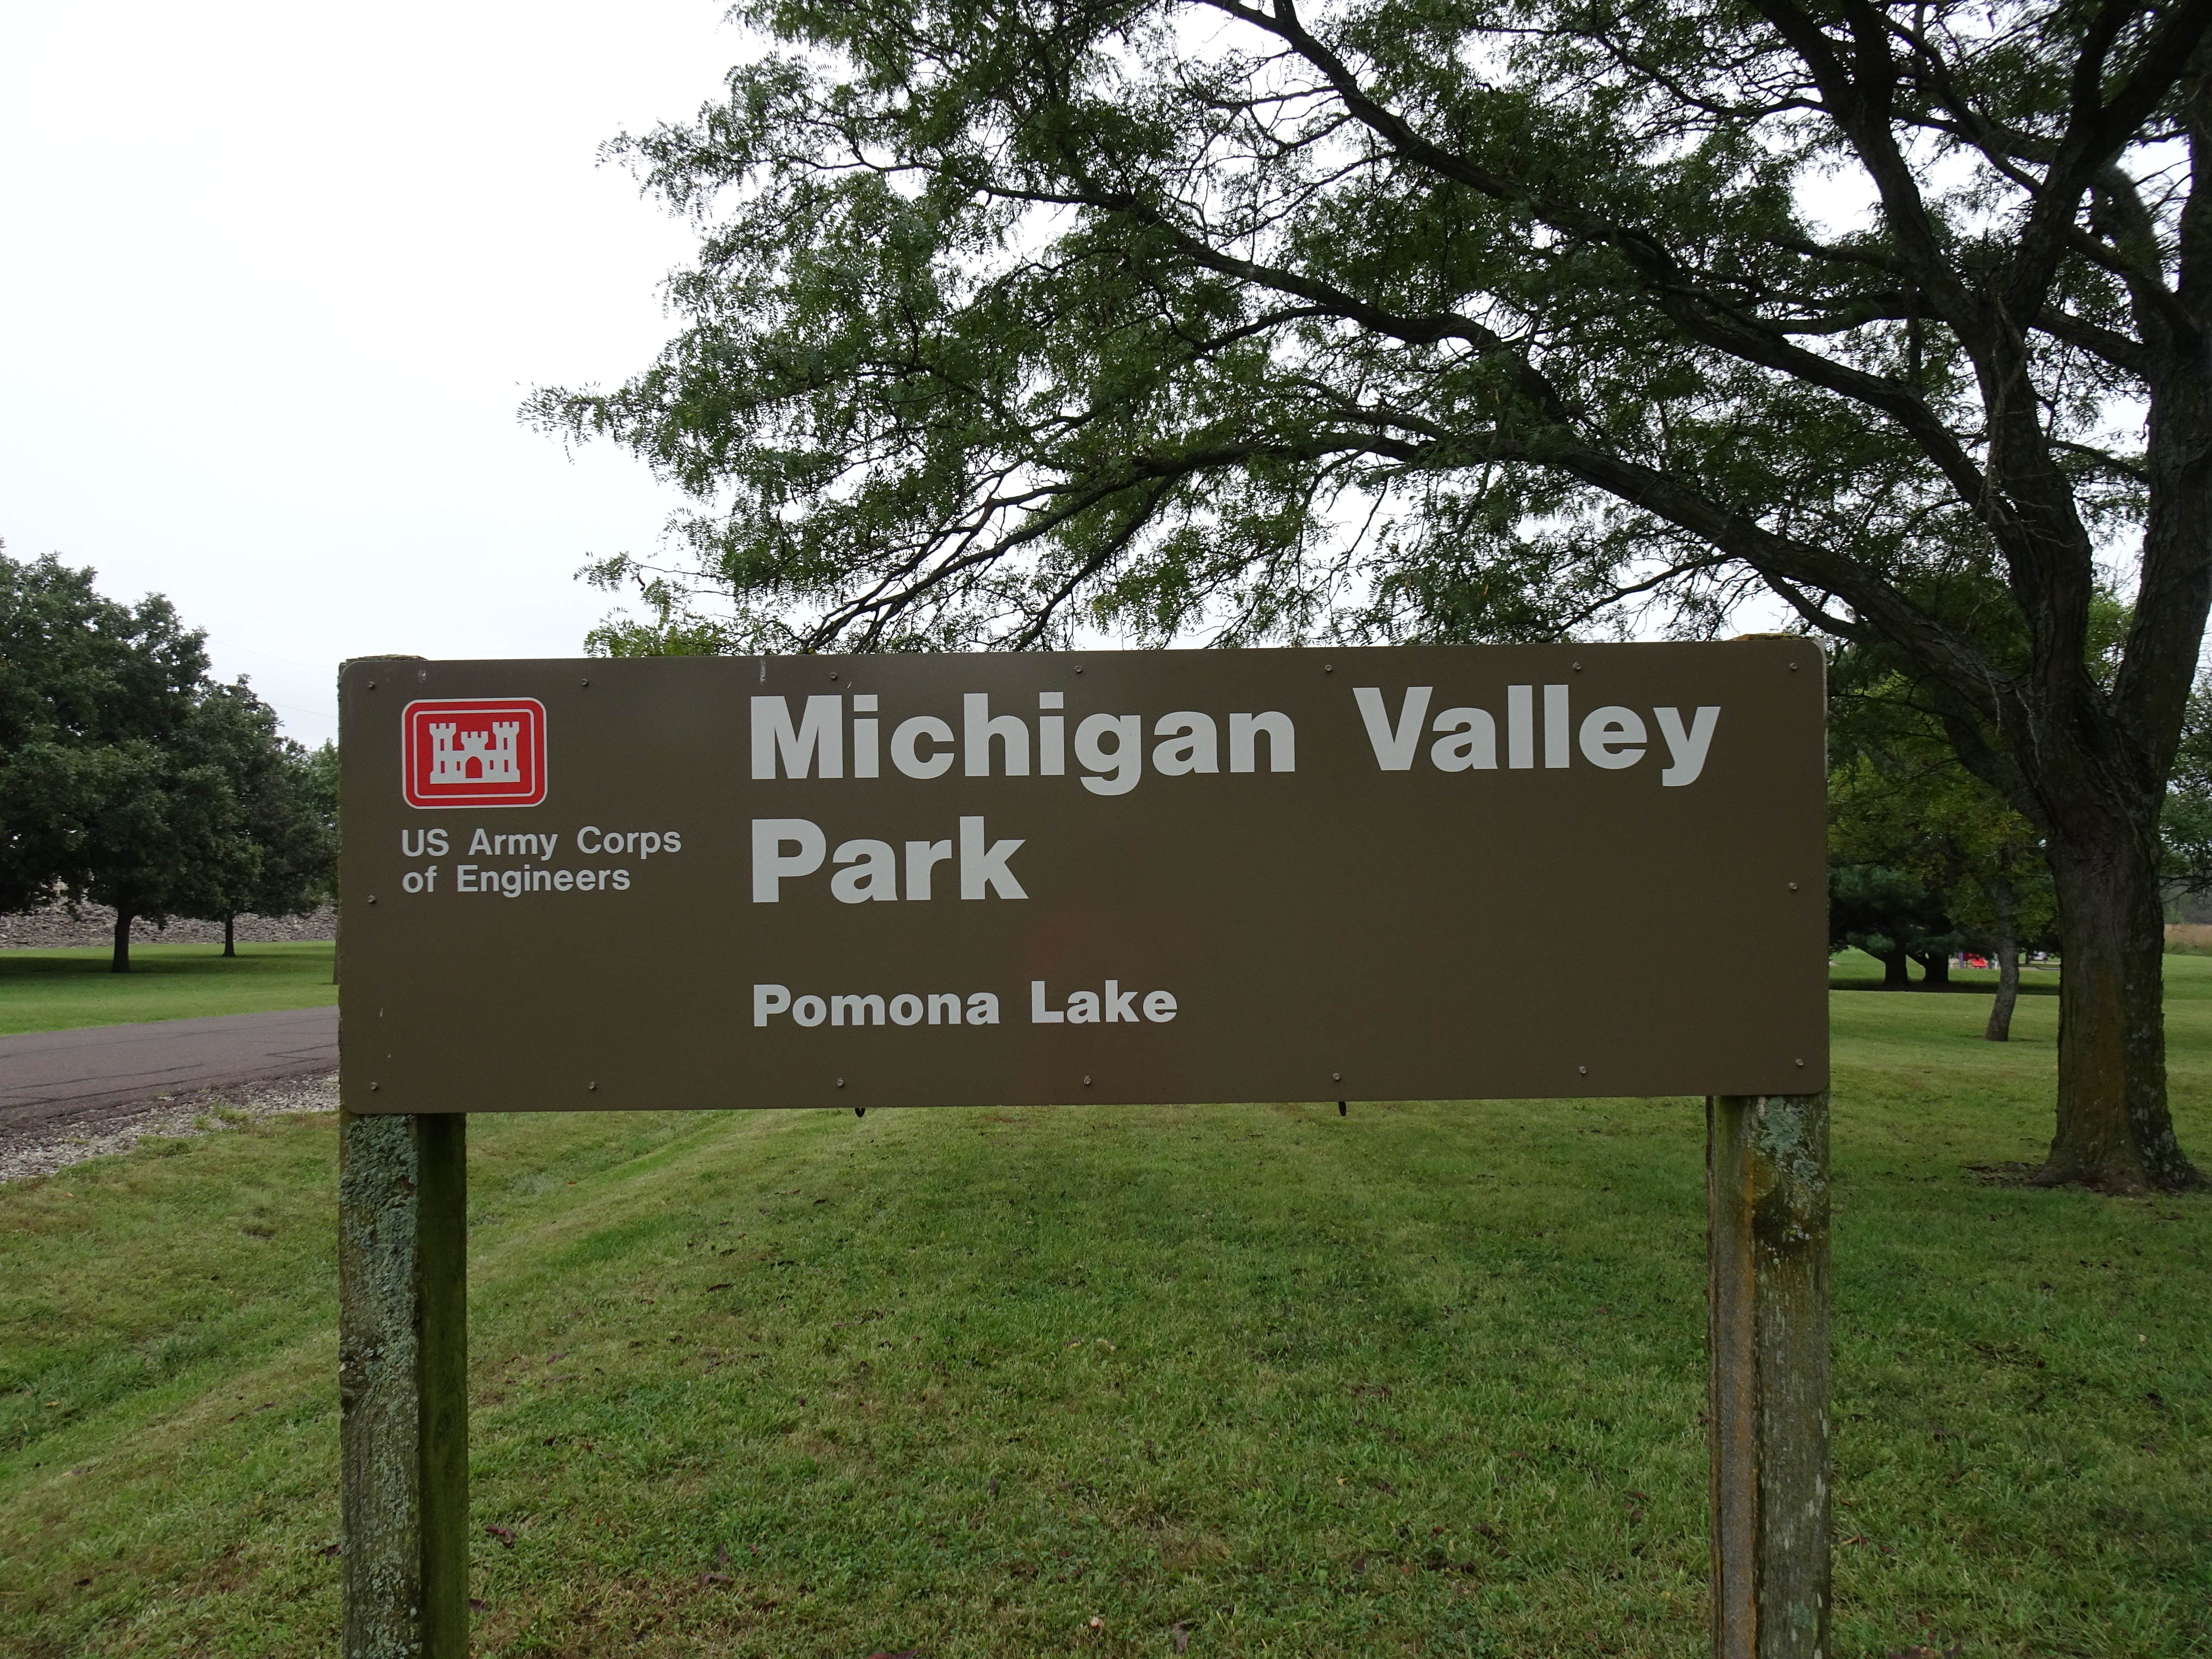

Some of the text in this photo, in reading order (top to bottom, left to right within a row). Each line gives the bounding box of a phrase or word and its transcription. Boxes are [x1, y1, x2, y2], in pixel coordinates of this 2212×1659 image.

[750, 684, 1721, 796] Michigan Valley
[402, 826, 682, 861] US Army Corps
[752, 816, 1029, 904] Park
[402, 865, 631, 898] of Engineers
[753, 979, 1178, 1027] Pomona Lake
